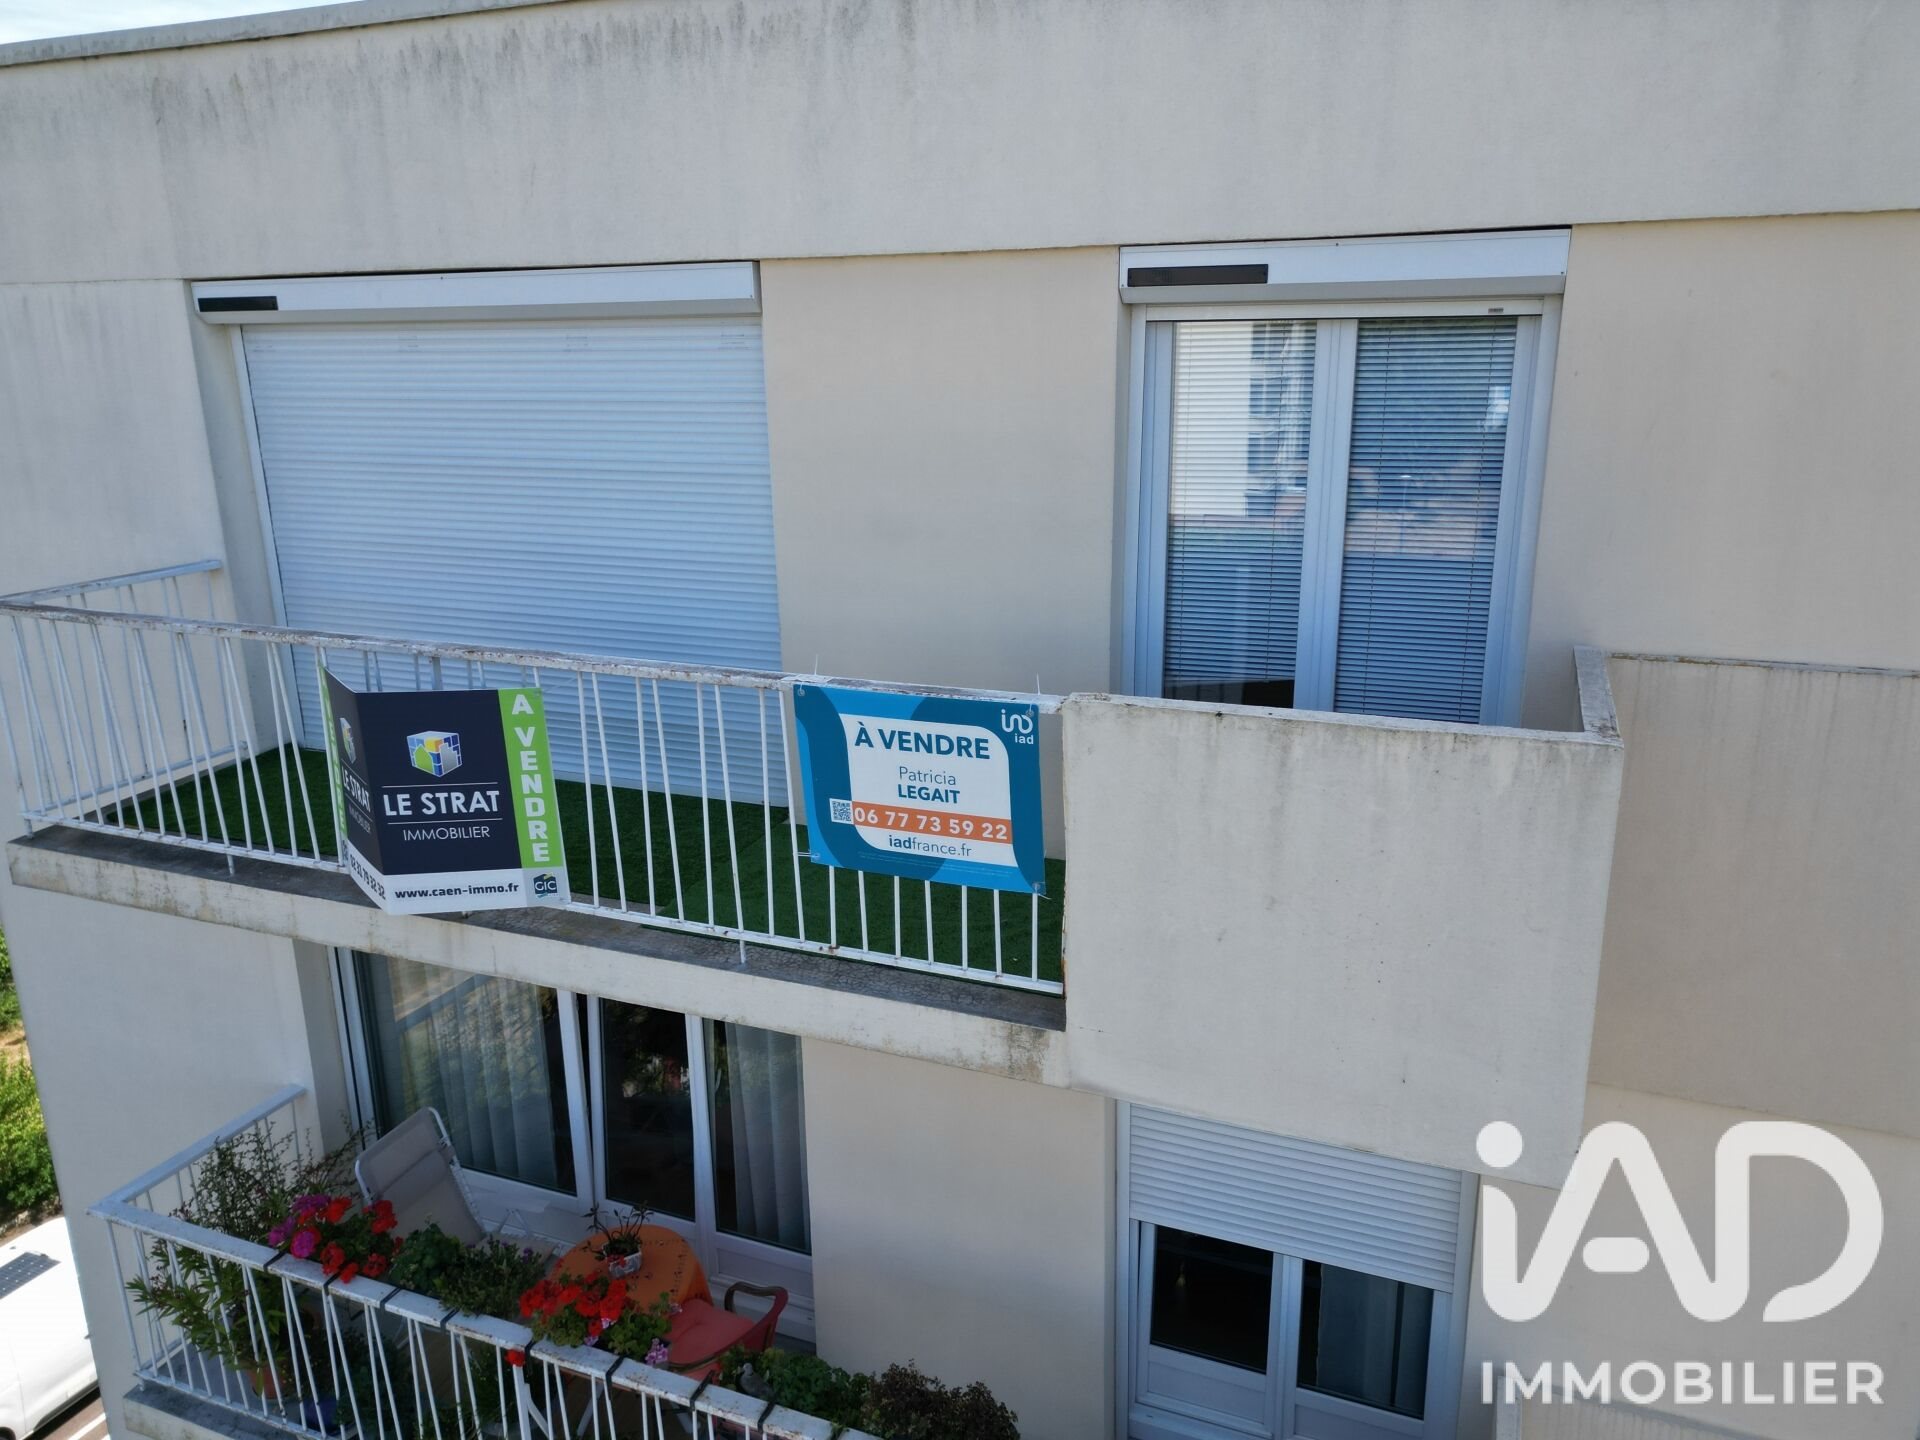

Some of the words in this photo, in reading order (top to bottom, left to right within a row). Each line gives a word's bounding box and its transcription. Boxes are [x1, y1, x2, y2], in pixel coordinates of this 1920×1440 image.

[511, 694, 535, 715] A
[854, 721, 874, 748] À
[878, 728, 990, 759] VENDRE
[1014, 732, 1034, 745] iad
[899, 766, 956, 786] Patricia
[342, 766, 351, 789] LE
[350, 775, 371, 812] STRAT
[513, 727, 550, 862] VENDRE
[898, 784, 960, 804] LEGAIT
[383, 793, 412, 816] LE
[422, 790, 500, 815] STRAT
[403, 826, 490, 841] IMMOBILIER
[854, 807, 879, 824] 06
[884, 811, 909, 828] 77
[916, 815, 942, 832] 73
[949, 819, 975, 836] 59
[981, 823, 1008, 840] 22
[888, 835, 973, 857] iadfrance.fr
[395, 883, 519, 899] www.caen-immo.fr
[534, 879, 557, 892] GIC
